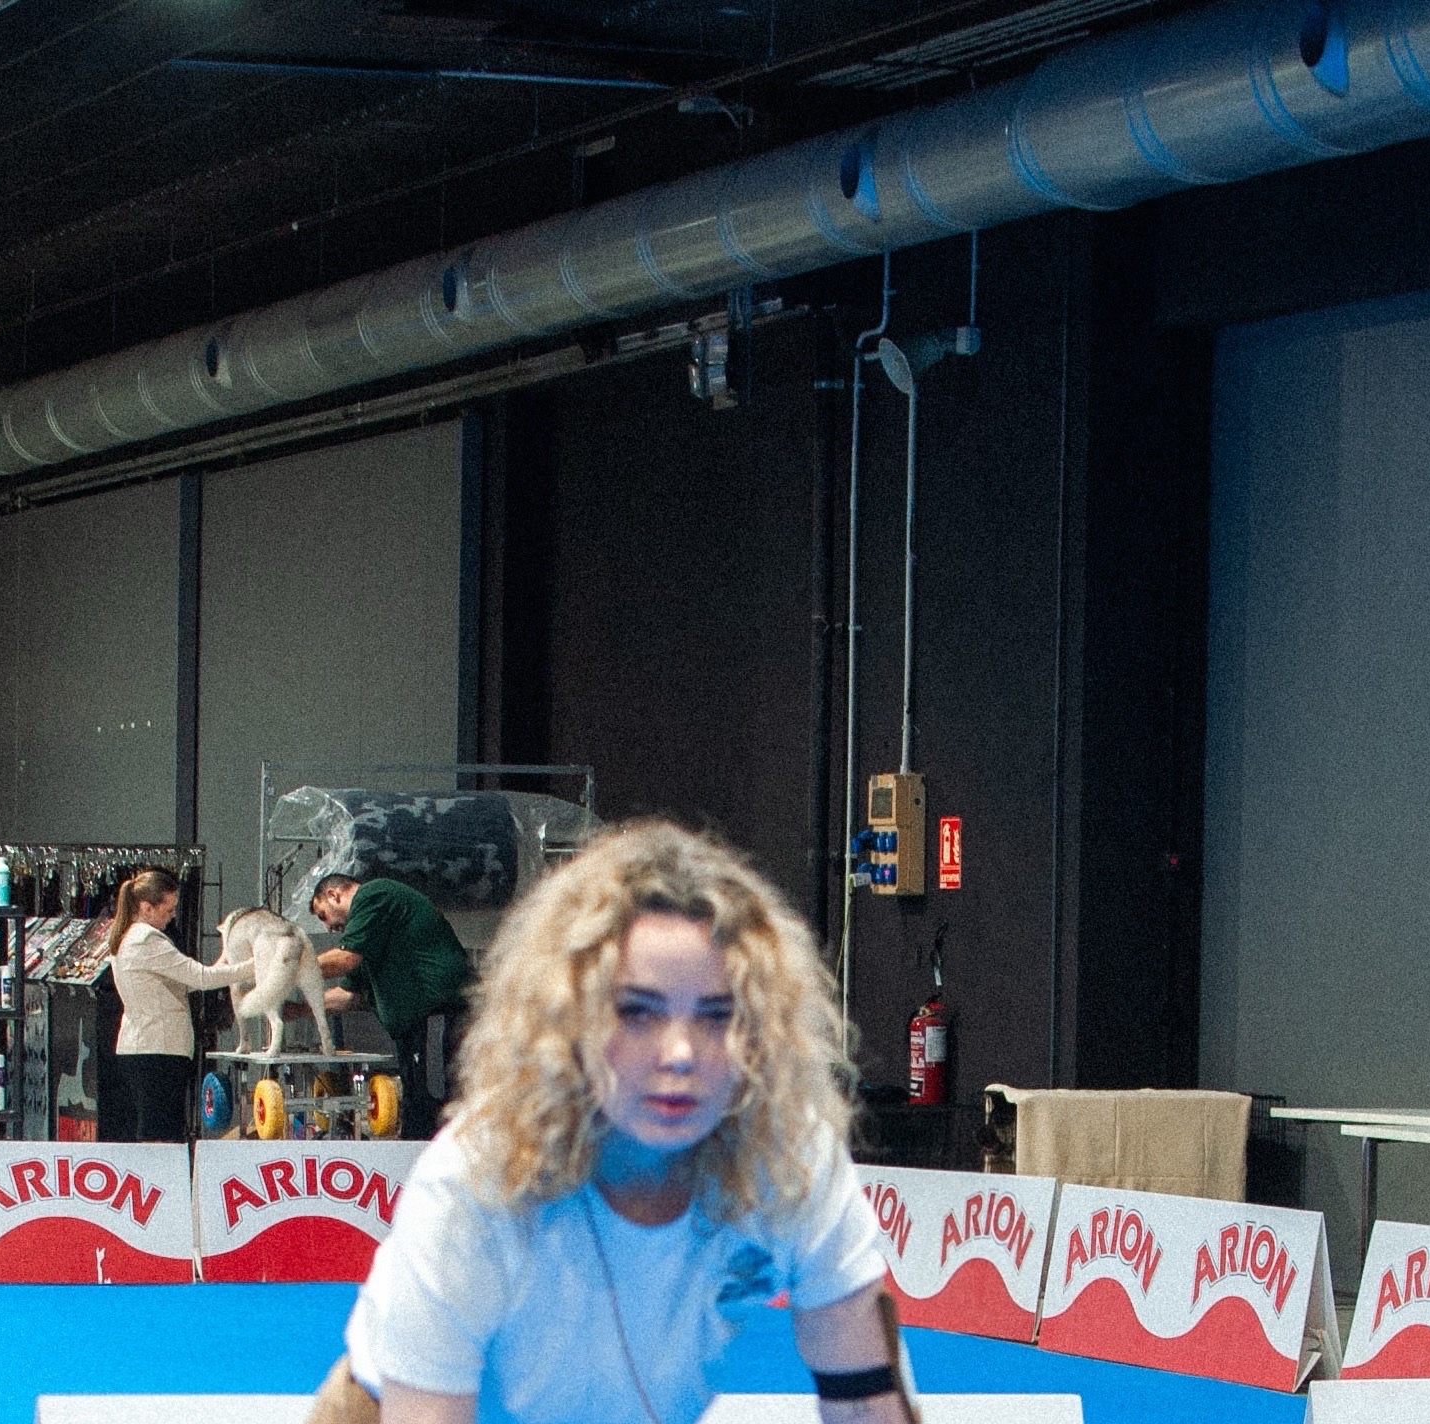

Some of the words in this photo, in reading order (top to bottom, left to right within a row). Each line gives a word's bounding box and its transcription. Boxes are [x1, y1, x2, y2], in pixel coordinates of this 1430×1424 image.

[220, 1156, 406, 1229] ARION
[940, 1192, 1034, 1269] ARION
[1063, 1208, 1162, 1293] ARION
[1191, 1224, 1298, 1314] ARION
